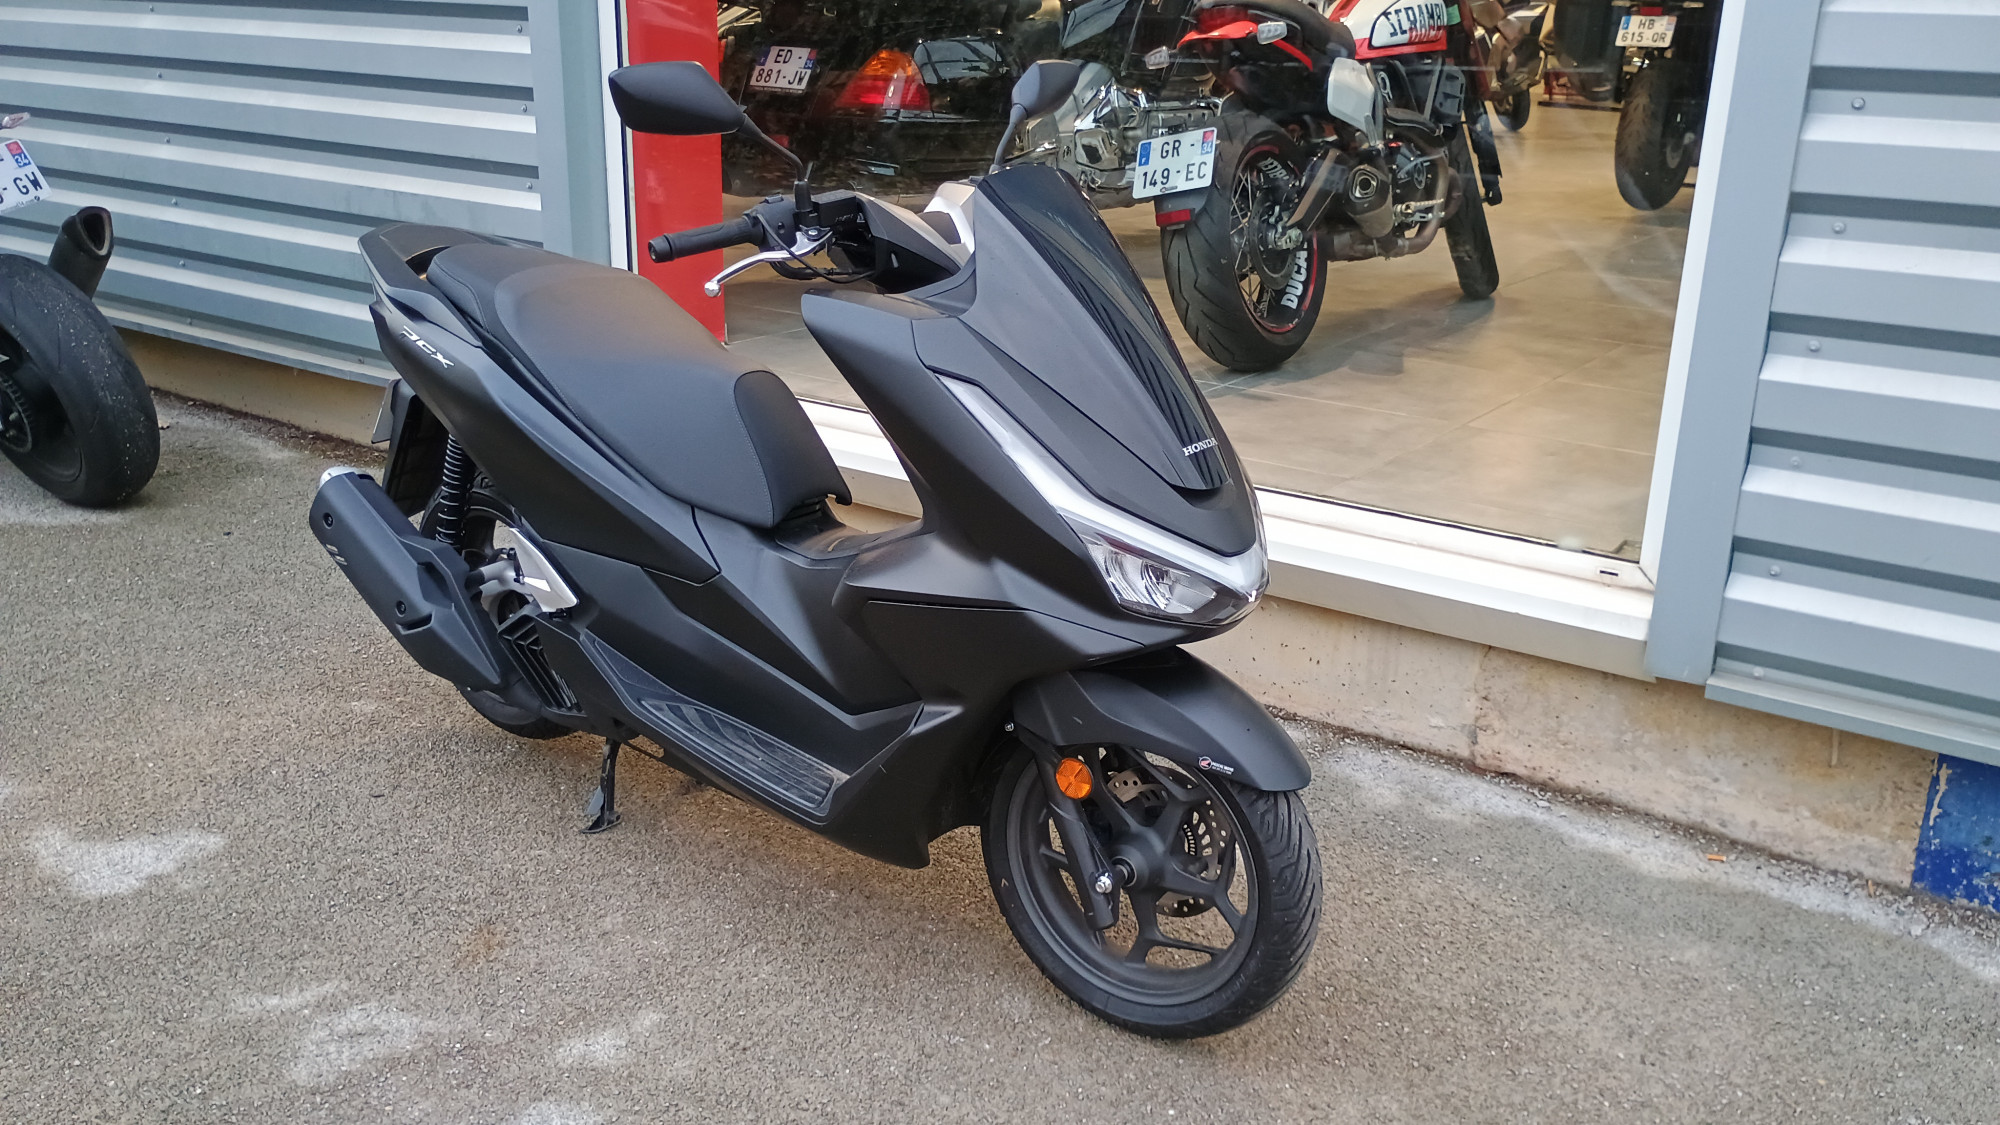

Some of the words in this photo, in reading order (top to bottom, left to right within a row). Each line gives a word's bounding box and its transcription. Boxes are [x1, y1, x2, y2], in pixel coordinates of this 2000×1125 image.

[773, 48, 793, 64] ED
[755, 68, 807, 86] 881-JW
[1160, 139, 1182, 159] GR
[1202, 143, 1212, 153] 34
[14, 153, 30, 166] 34
[1142, 161, 1208, 189] 149-EC
[1280, 241, 1309, 310] DUCA
[1182, 437, 1218, 457] HONDA
